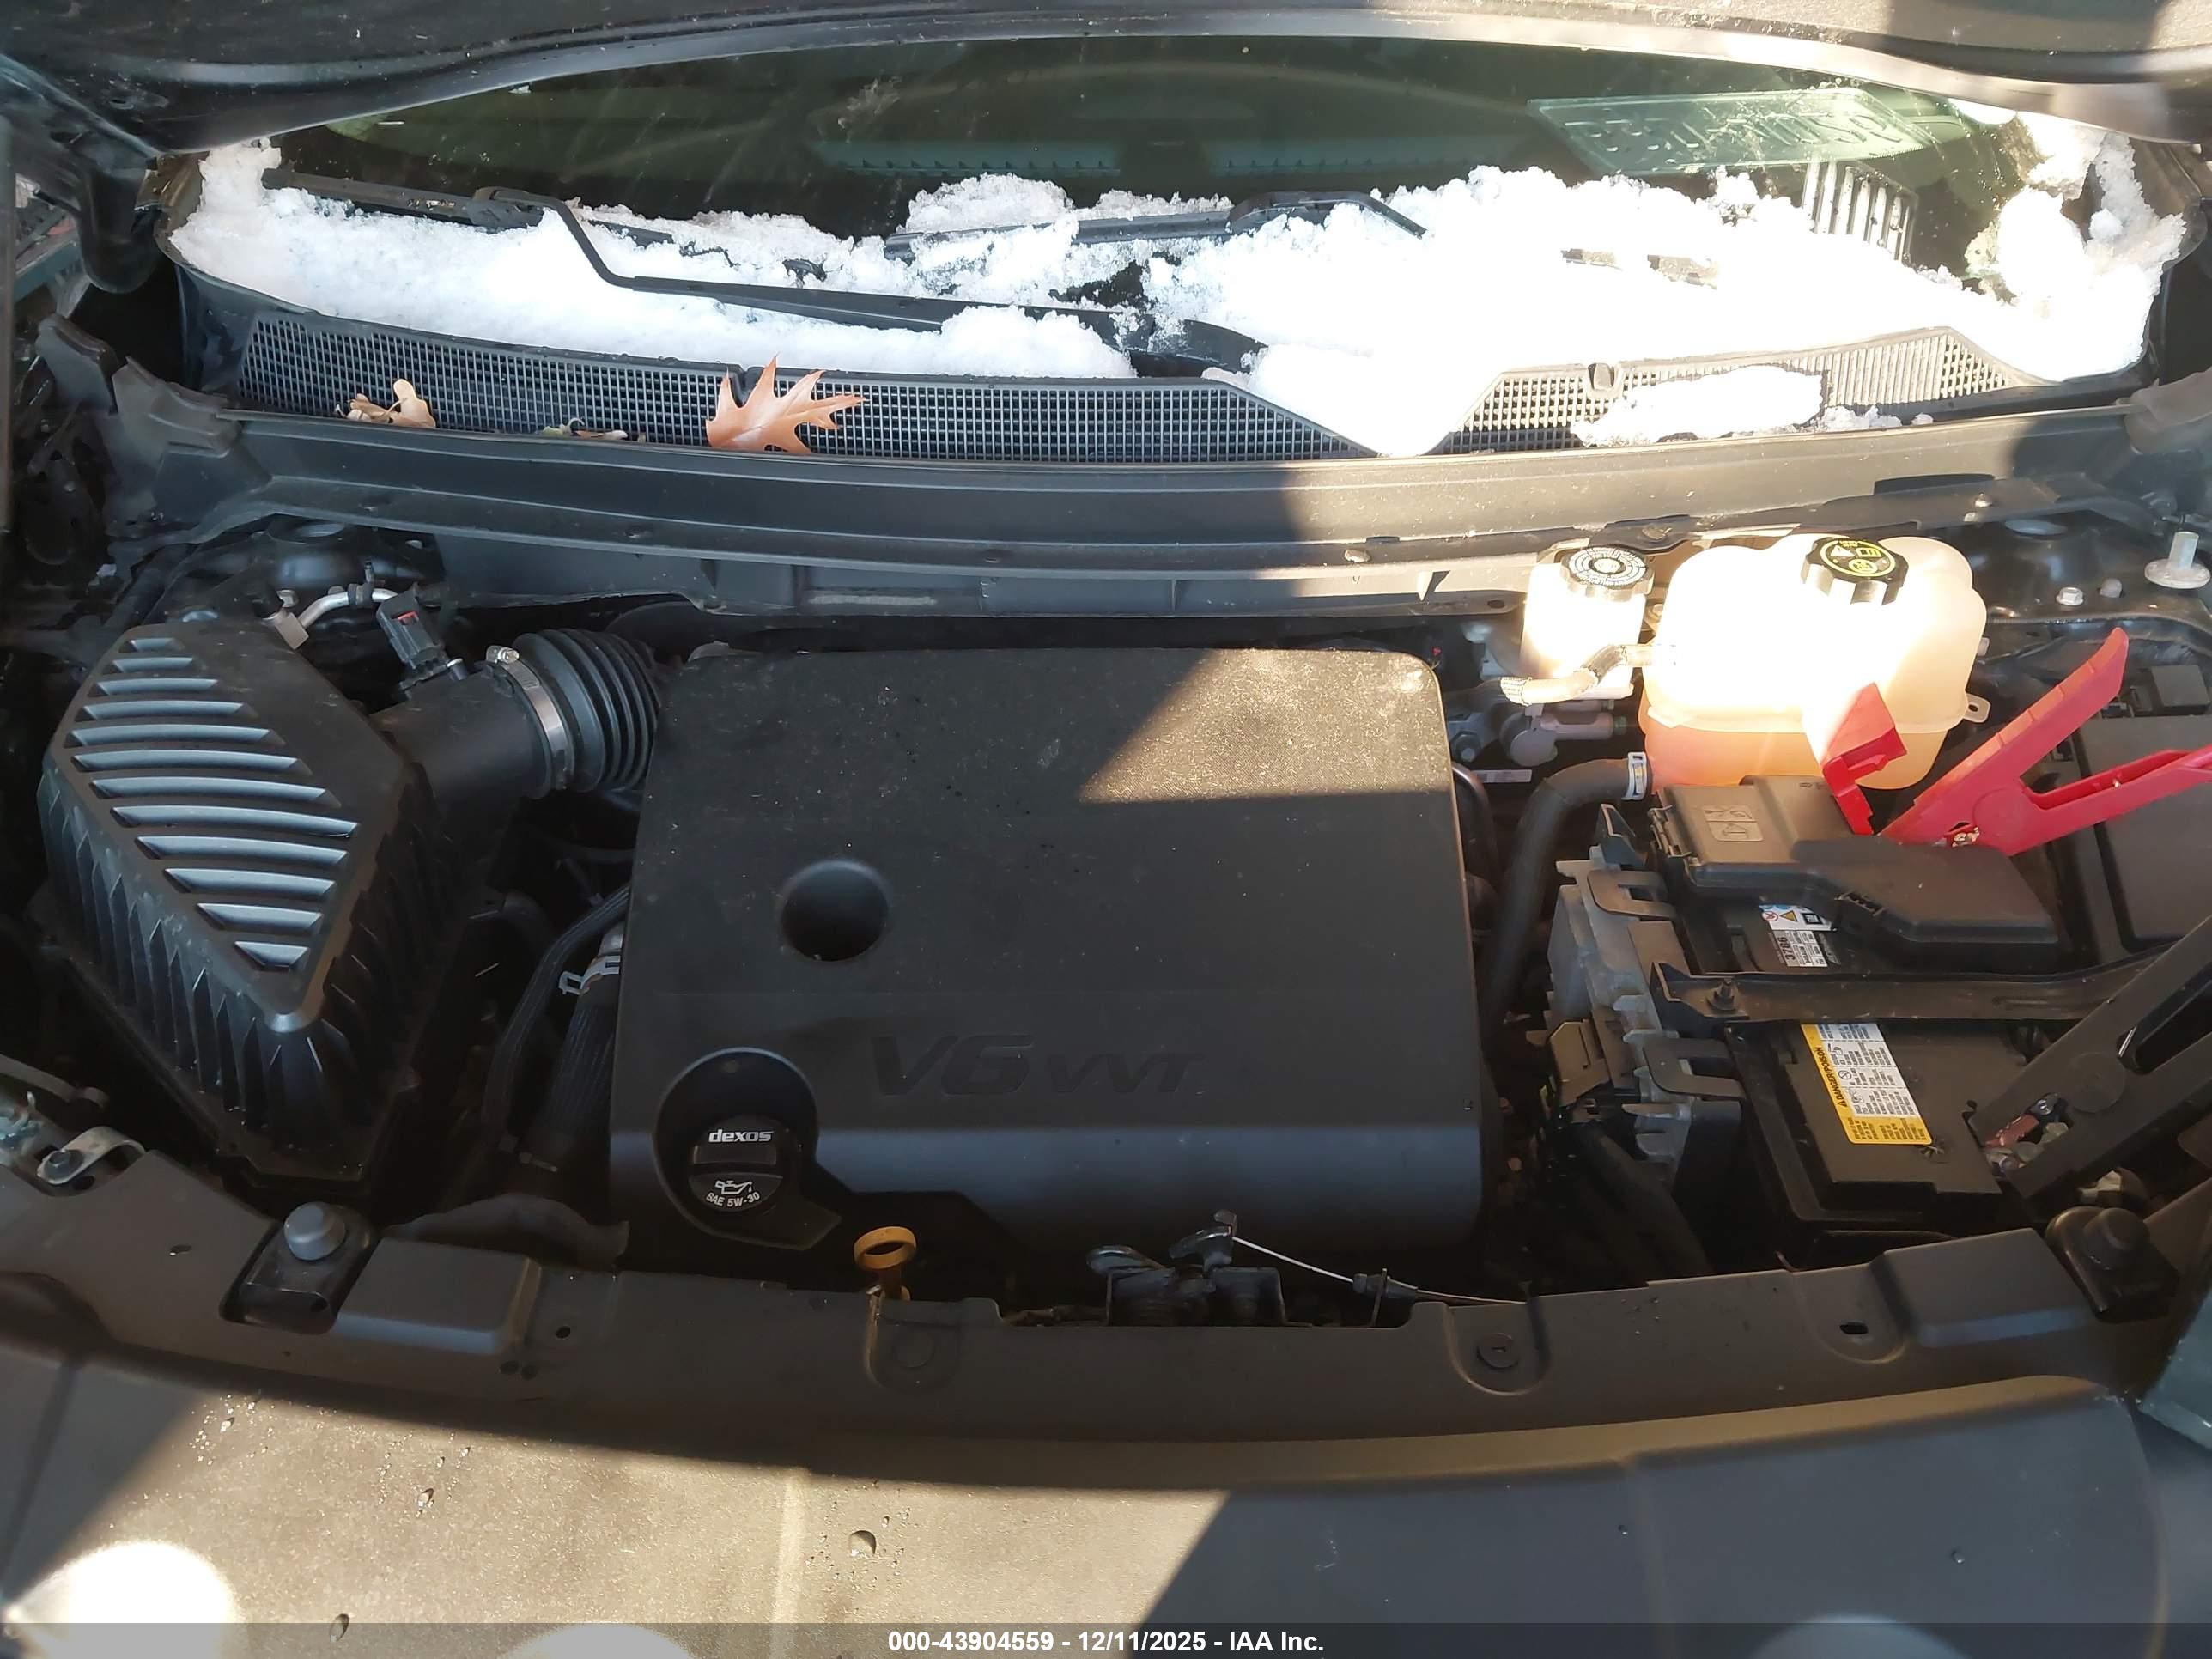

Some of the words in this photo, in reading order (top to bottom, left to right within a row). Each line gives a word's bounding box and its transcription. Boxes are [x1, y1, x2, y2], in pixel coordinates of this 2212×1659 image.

[871, 1035, 1034, 1095] V6
[708, 1129, 774, 1143] dexos
[706, 1192, 724, 1207] SAE
[727, 1191, 761, 1207] 5W-30
